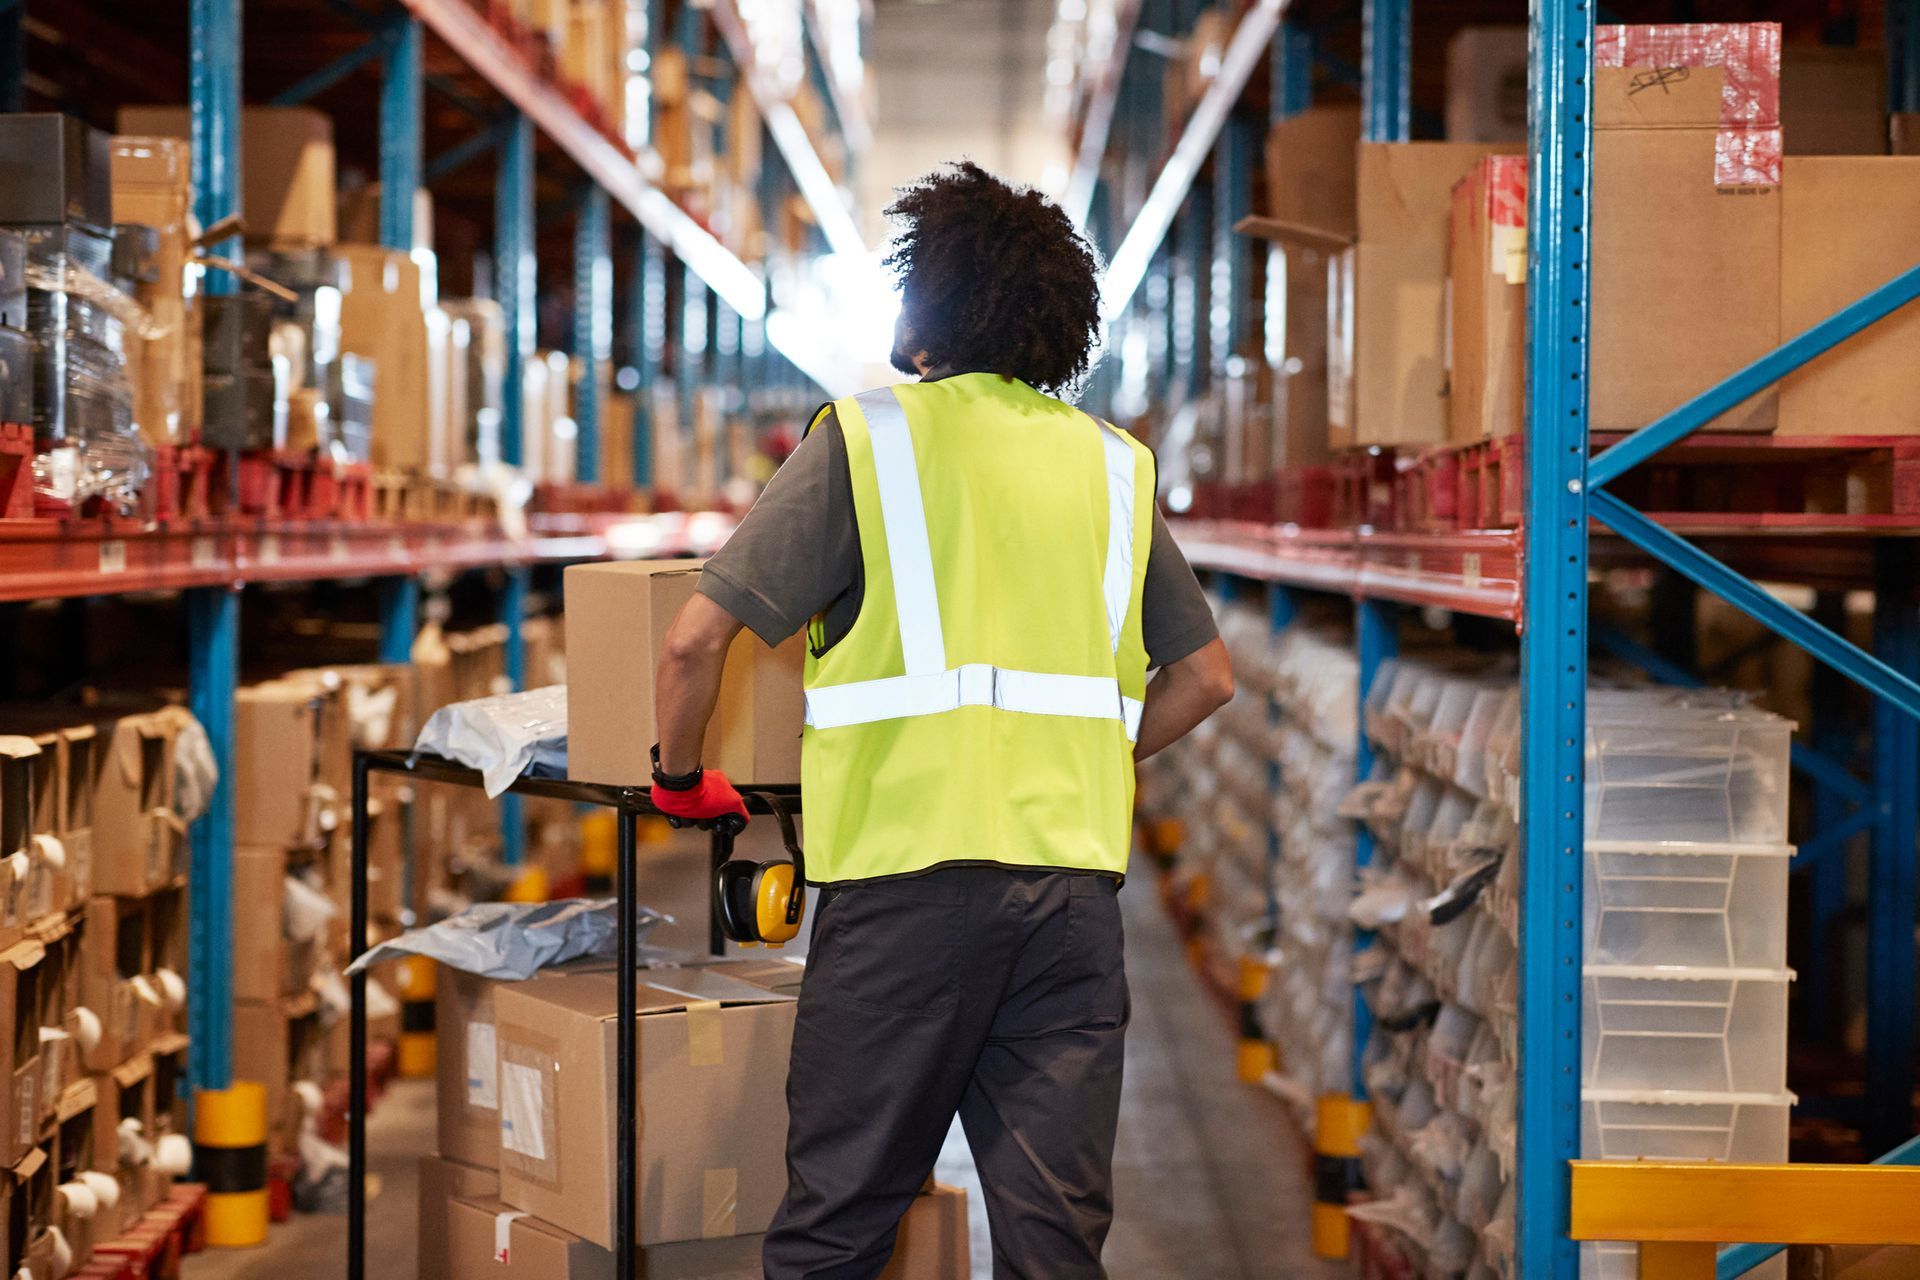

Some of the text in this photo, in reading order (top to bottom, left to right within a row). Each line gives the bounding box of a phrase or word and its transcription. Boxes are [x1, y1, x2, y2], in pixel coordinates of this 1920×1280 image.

[1716, 187, 1771, 195] THIS SIDE UP
